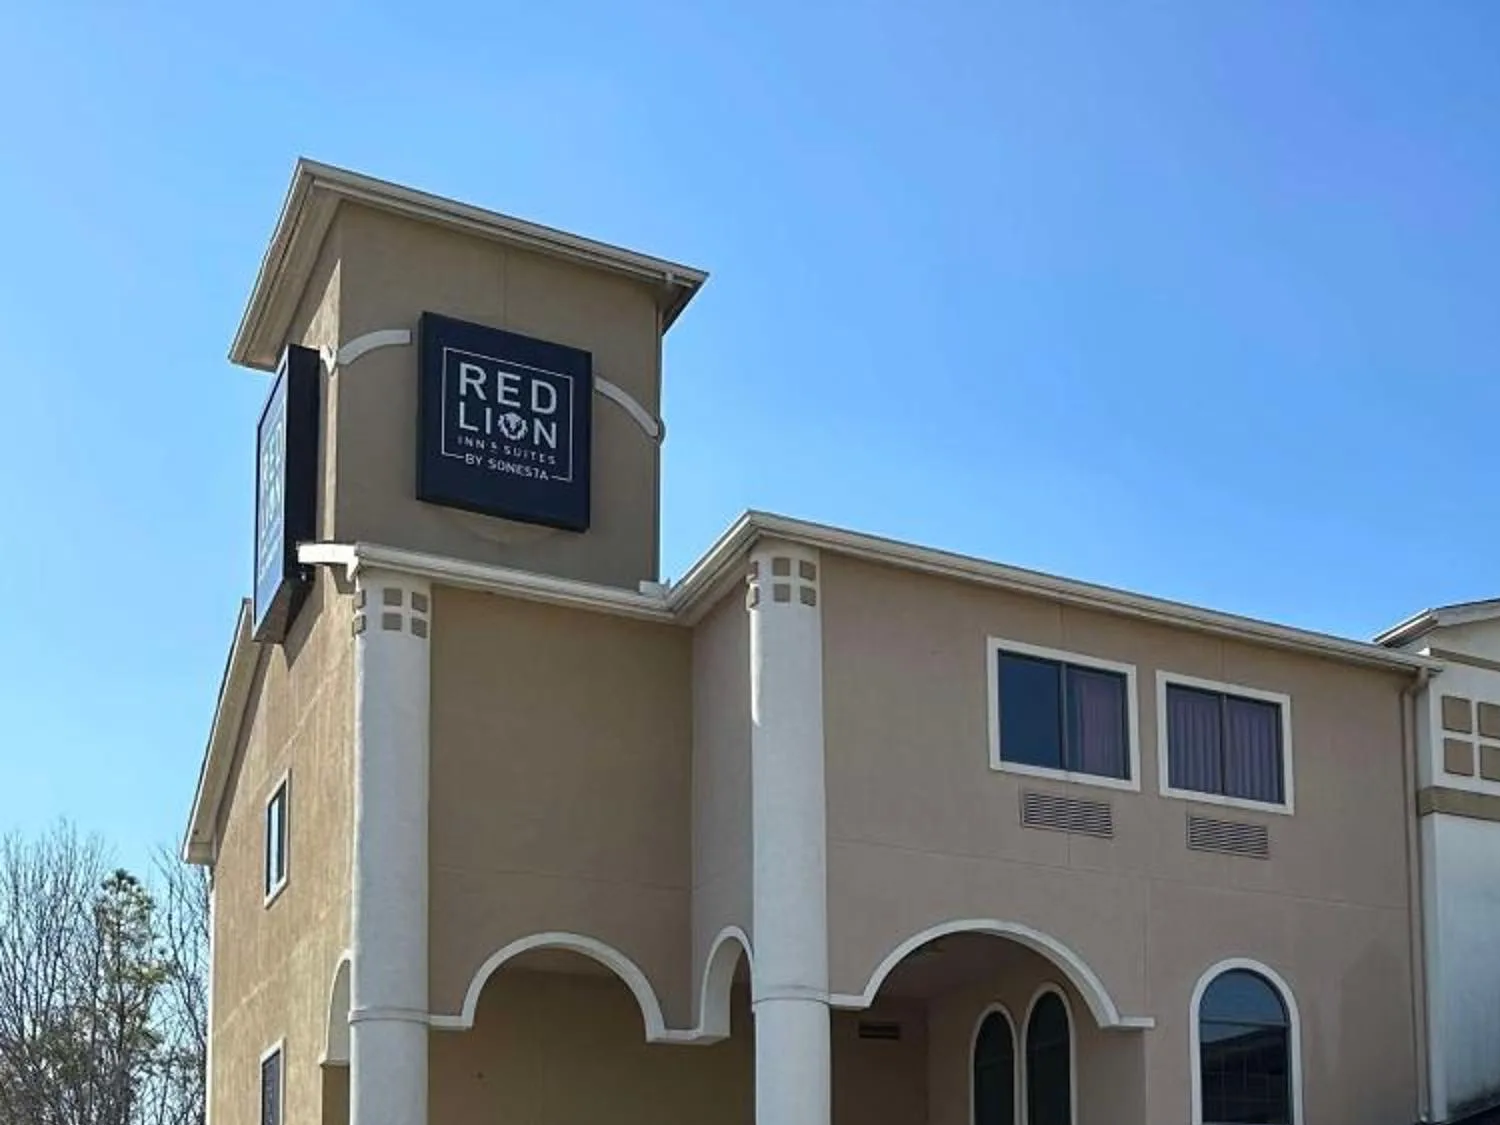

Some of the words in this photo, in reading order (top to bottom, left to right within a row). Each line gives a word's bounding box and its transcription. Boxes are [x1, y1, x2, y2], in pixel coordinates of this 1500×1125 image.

[460, 362, 557, 415] RED
[459, 401, 557, 449] LION
[458, 436, 485, 449] INN
[503, 445, 556, 465] SUITES
[465, 453, 482, 465] BY
[488, 458, 549, 480] SONESTA
